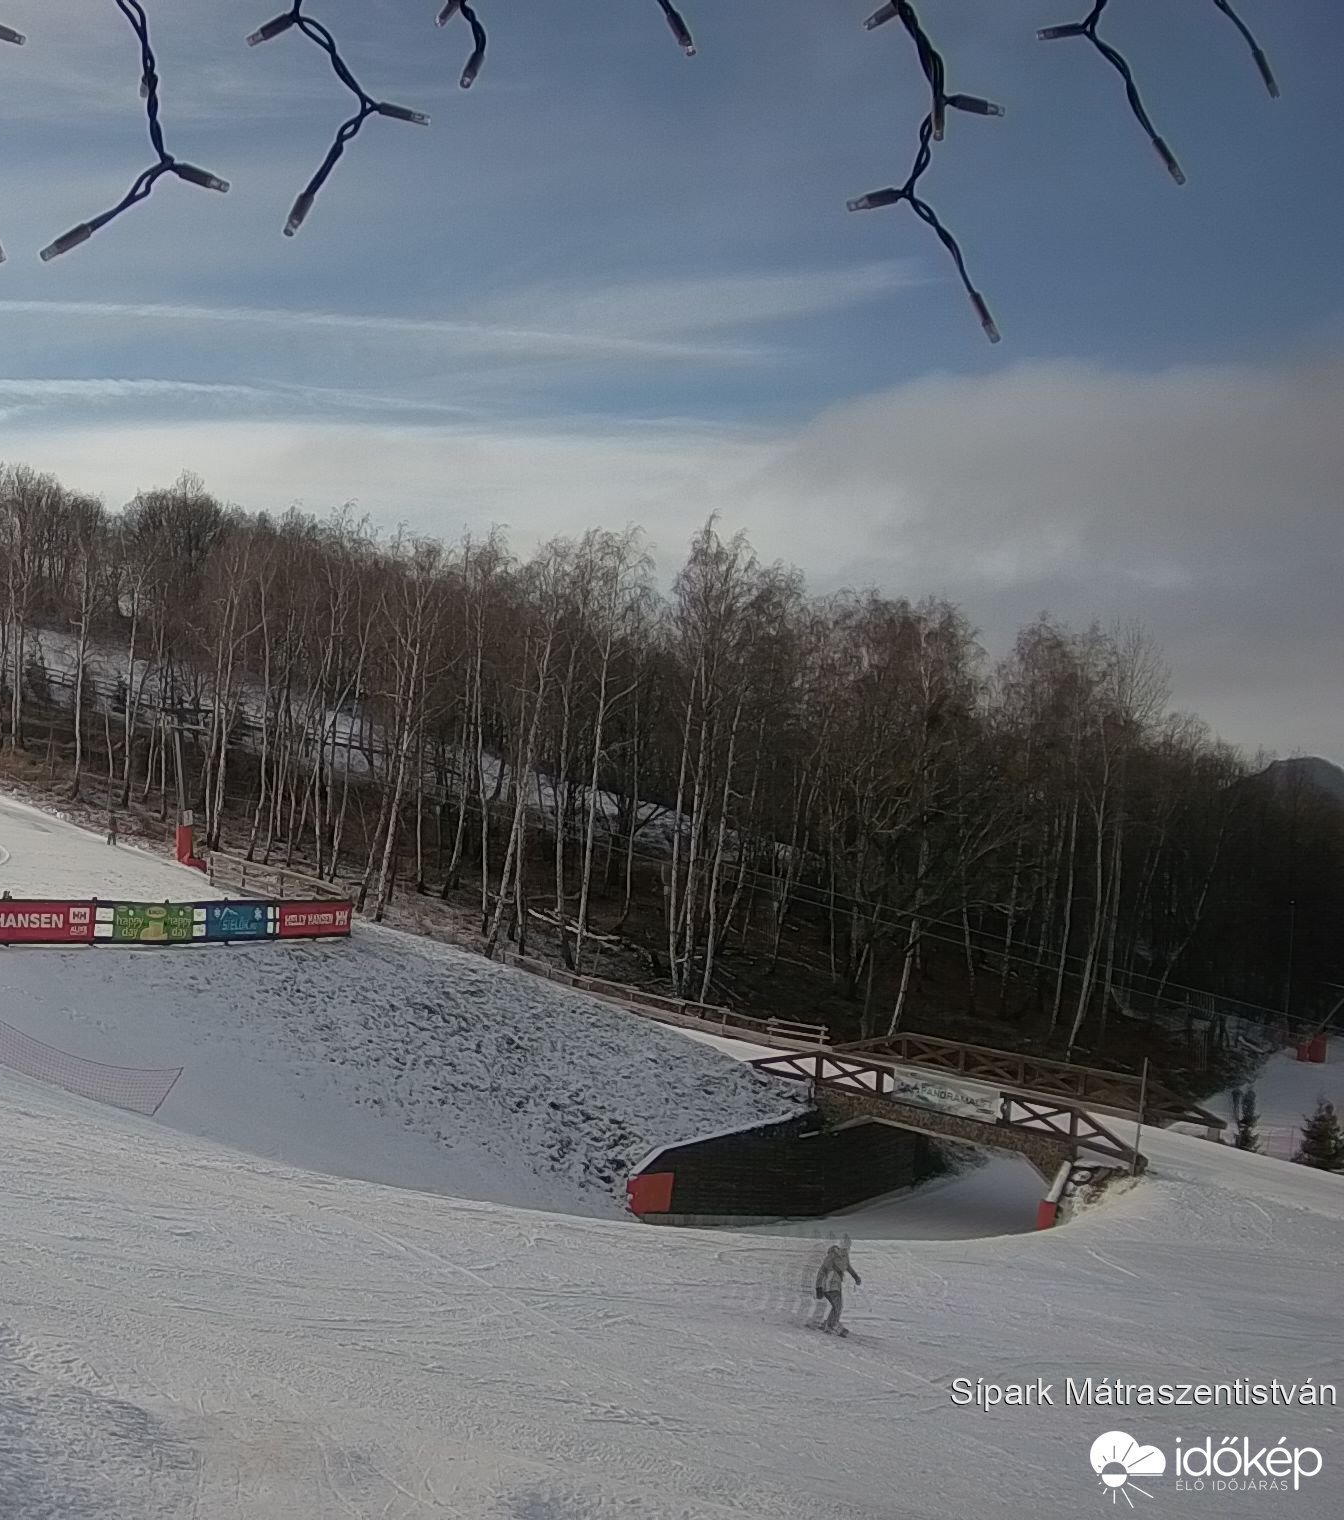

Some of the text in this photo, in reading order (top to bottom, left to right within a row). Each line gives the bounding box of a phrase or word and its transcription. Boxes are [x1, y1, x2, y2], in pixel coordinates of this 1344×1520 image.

[116, 914, 143, 929] happy
[121, 926, 138, 939] day
[171, 926, 188, 939] day
